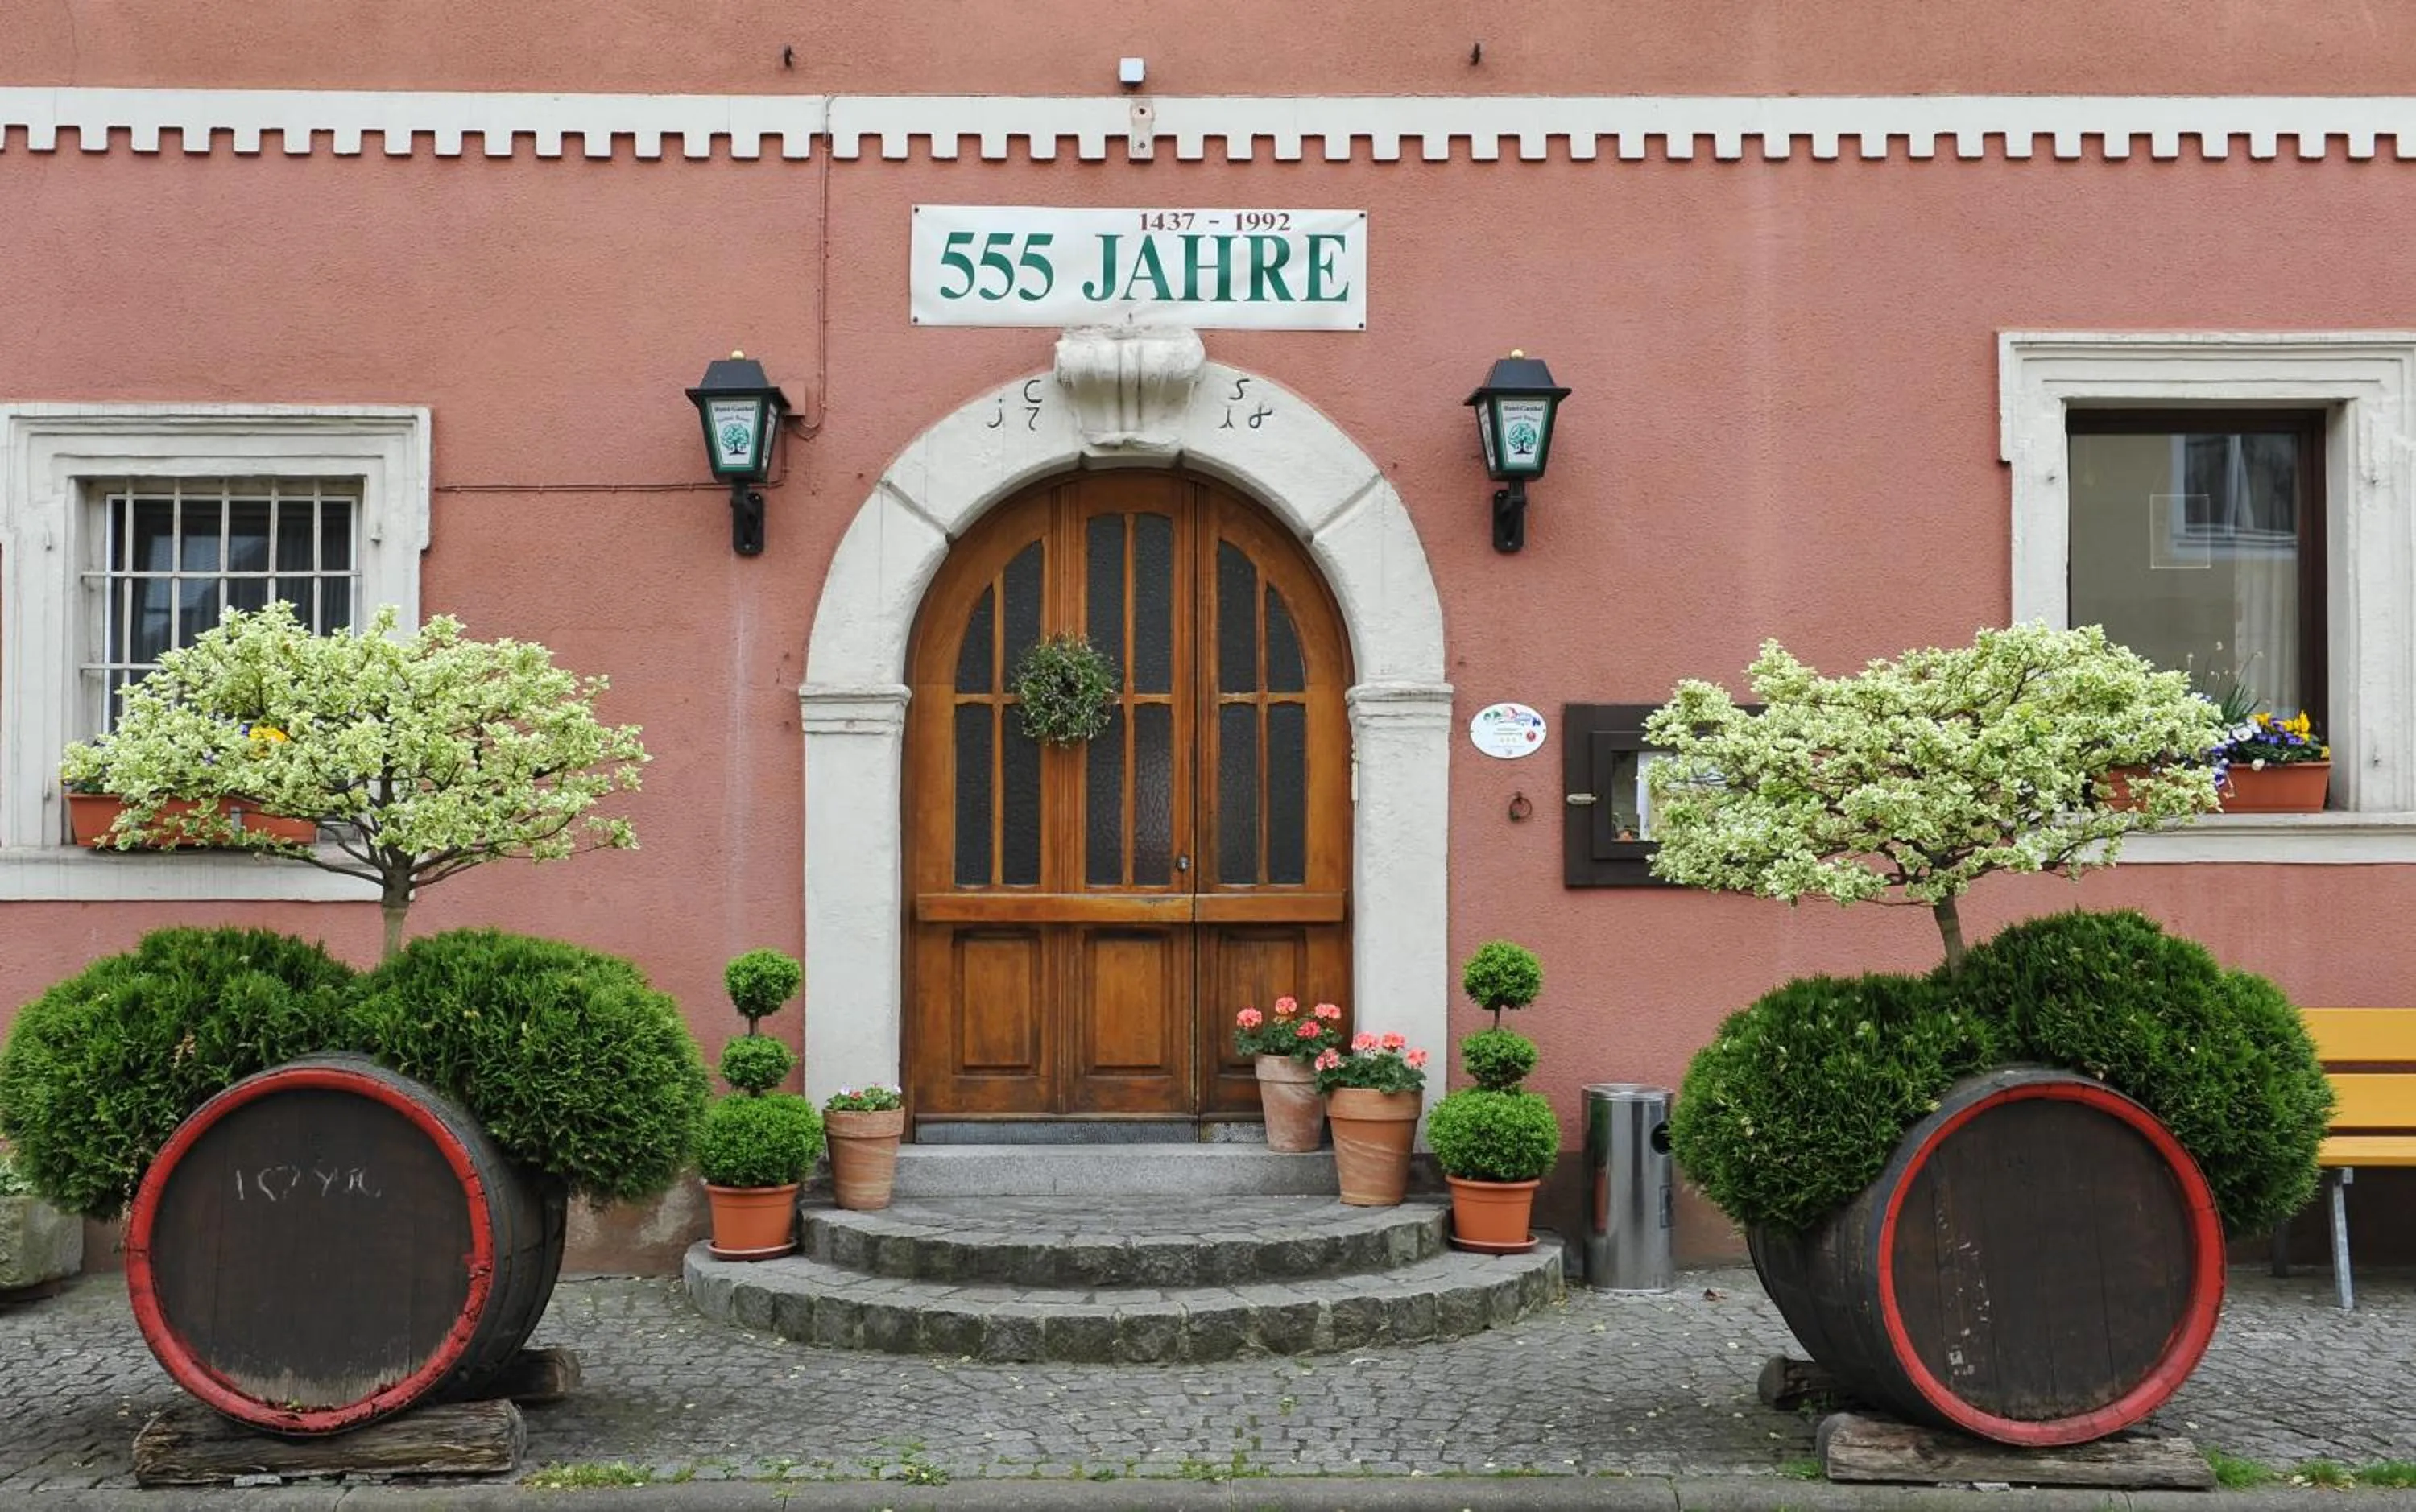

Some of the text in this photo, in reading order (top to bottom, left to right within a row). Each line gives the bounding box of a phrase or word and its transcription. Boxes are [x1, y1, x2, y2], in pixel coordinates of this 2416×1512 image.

[1140, 213, 1195, 231] 1437
[1235, 213, 1291, 231] 1992
[940, 232, 1350, 303] 555 JAHRE
